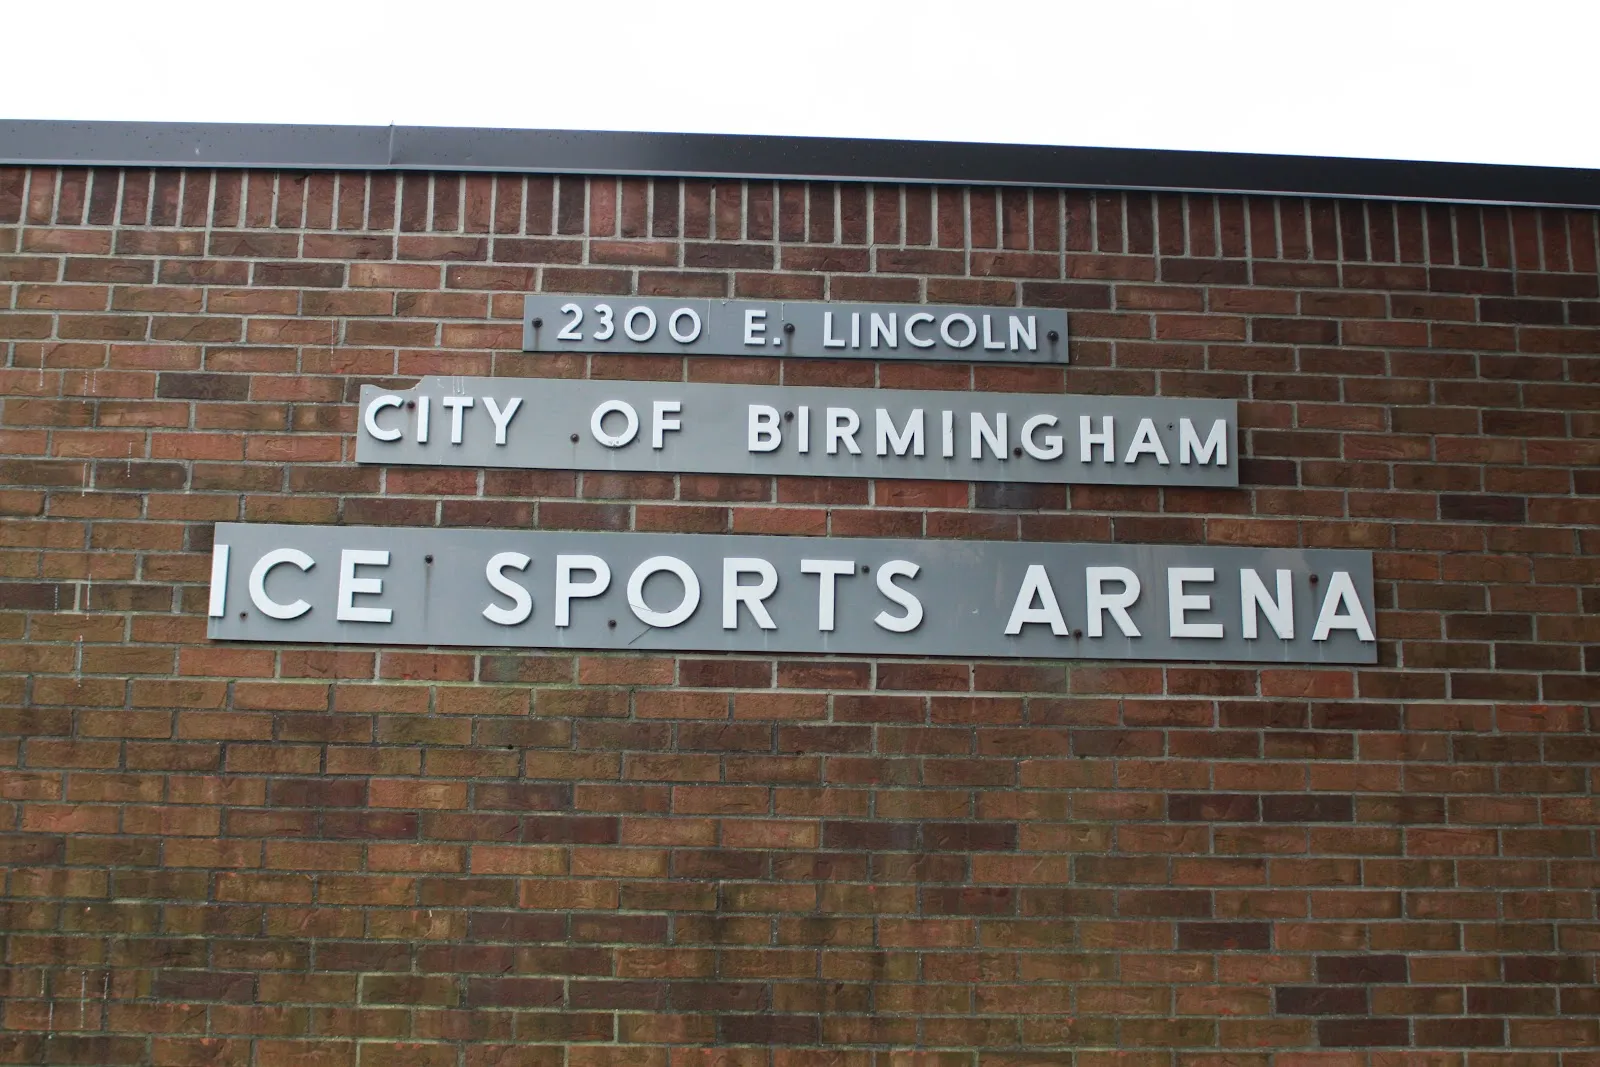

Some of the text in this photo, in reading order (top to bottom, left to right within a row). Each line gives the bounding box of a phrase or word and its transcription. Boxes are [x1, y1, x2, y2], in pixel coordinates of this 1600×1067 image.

[557, 303, 1036, 349] 2300 E. LINCOLN
[364, 395, 1226, 464] CITY OF BIRMINGHAM
[209, 544, 1374, 640] ICE SPORTS ARENA
